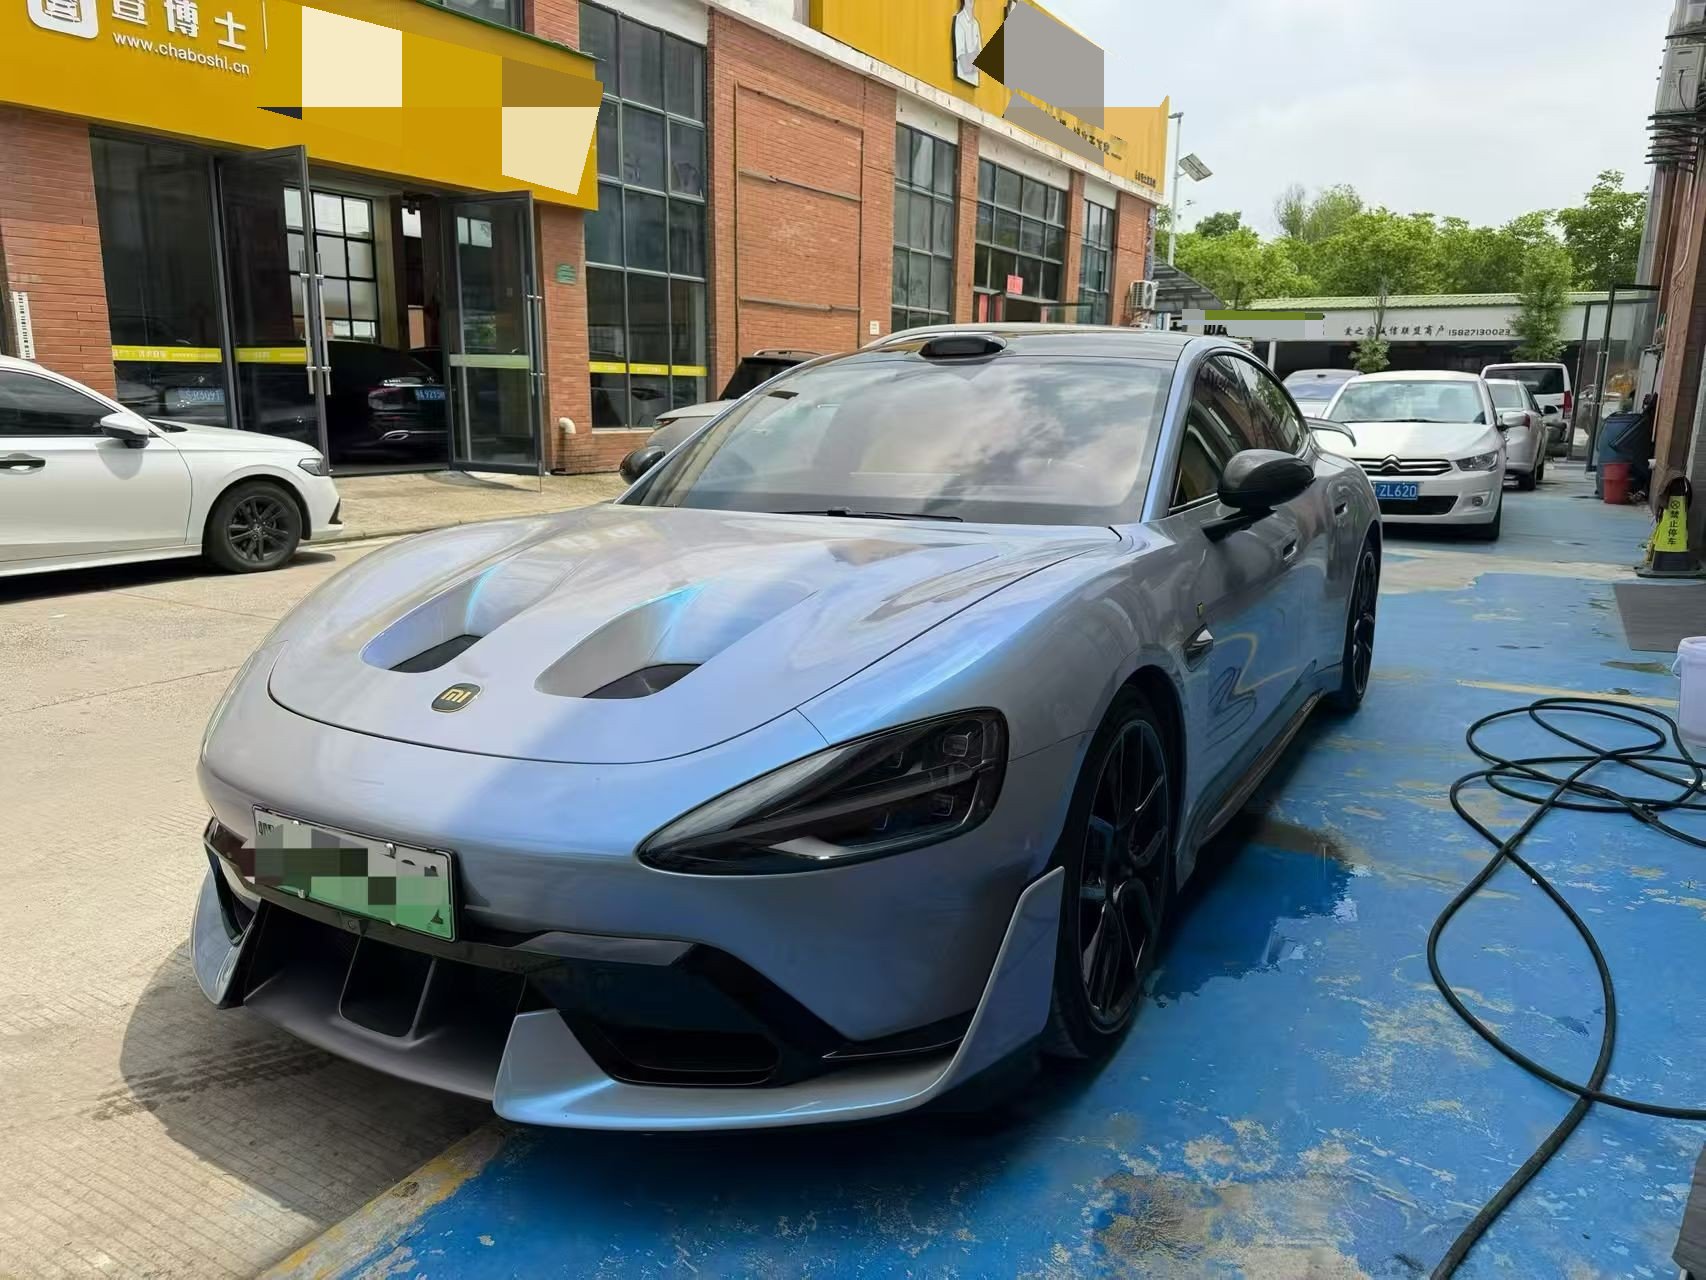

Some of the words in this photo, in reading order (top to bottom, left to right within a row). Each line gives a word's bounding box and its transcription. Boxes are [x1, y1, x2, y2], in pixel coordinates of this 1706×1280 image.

[112, 31, 250, 75] www.chaboshi.cn
[1448, 328, 1511, 337] 15827130023
[1667, 510, 1680, 546] 禁止停车
